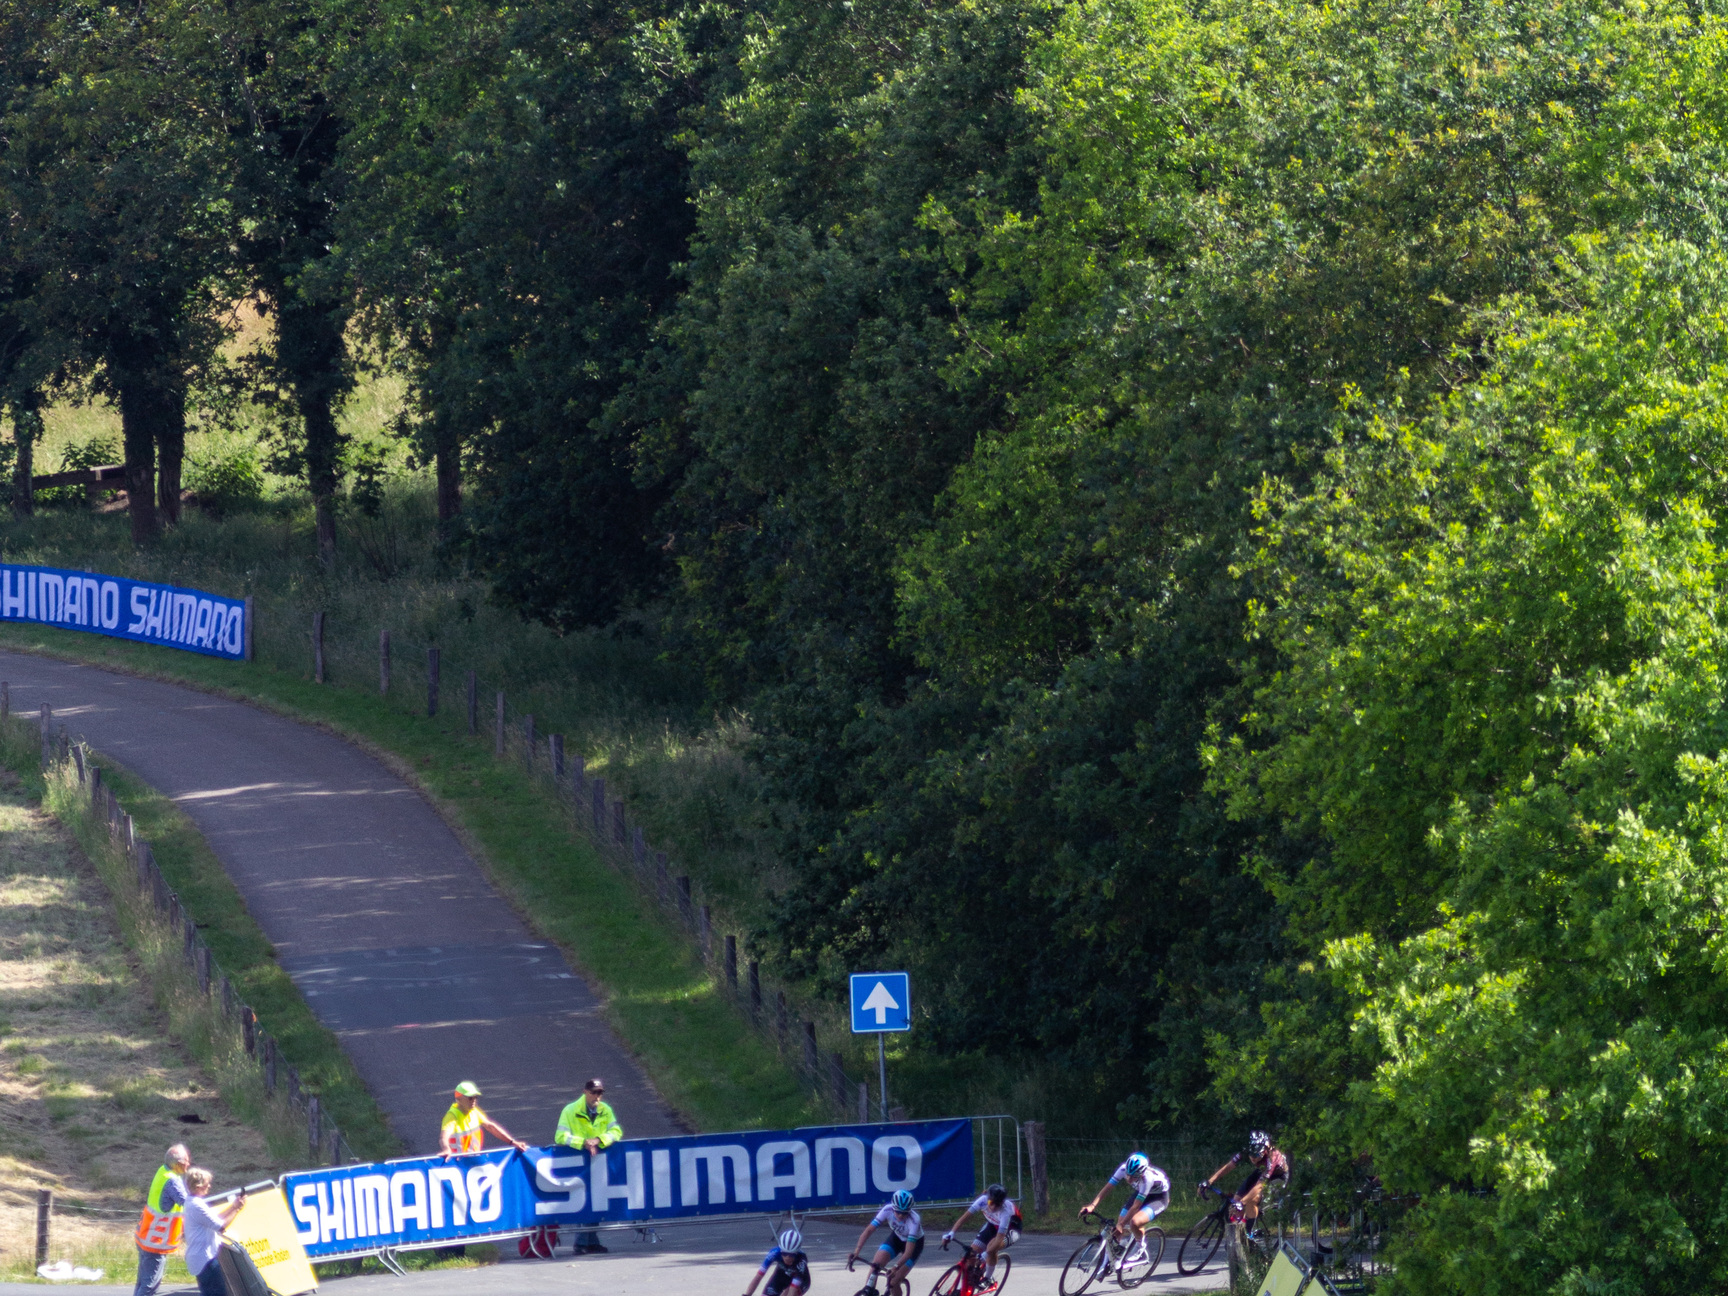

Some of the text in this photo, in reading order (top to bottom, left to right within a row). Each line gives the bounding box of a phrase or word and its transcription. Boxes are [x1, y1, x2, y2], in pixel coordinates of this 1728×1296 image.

[0, 569, 243, 655] HIMANO SHIMANO
[293, 1135, 923, 1246] SHIMANO SHIMANO
